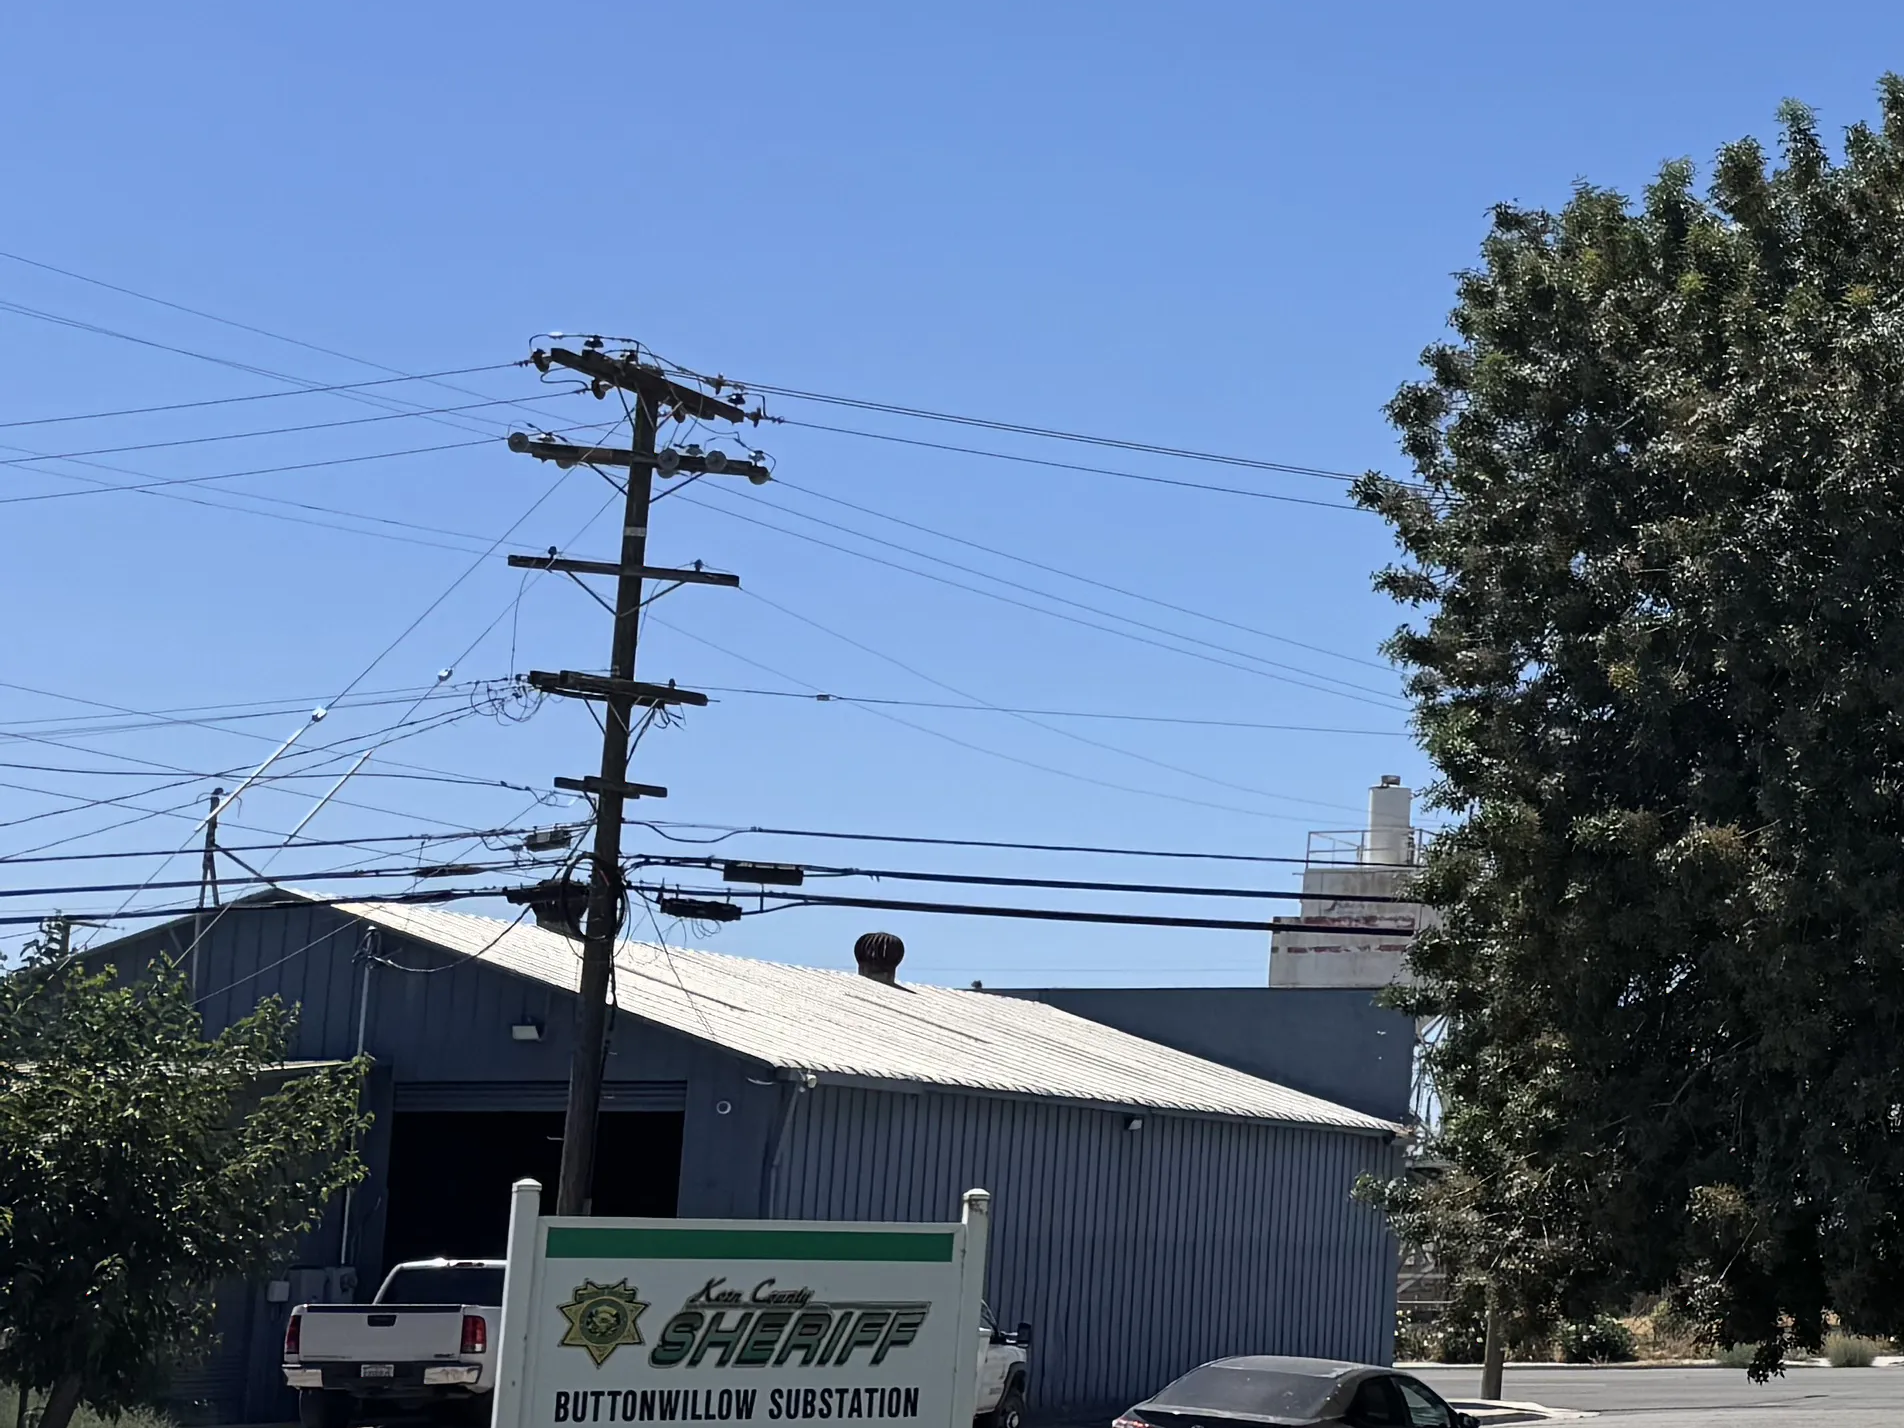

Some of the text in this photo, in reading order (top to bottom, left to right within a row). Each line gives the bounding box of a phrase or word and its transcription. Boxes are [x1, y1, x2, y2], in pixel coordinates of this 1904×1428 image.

[688, 1276, 815, 1308] Kern County
[648, 1308, 929, 1368] SHERIFF
[554, 1386, 920, 1423] BUTTONWILLOW SUBSTATION
